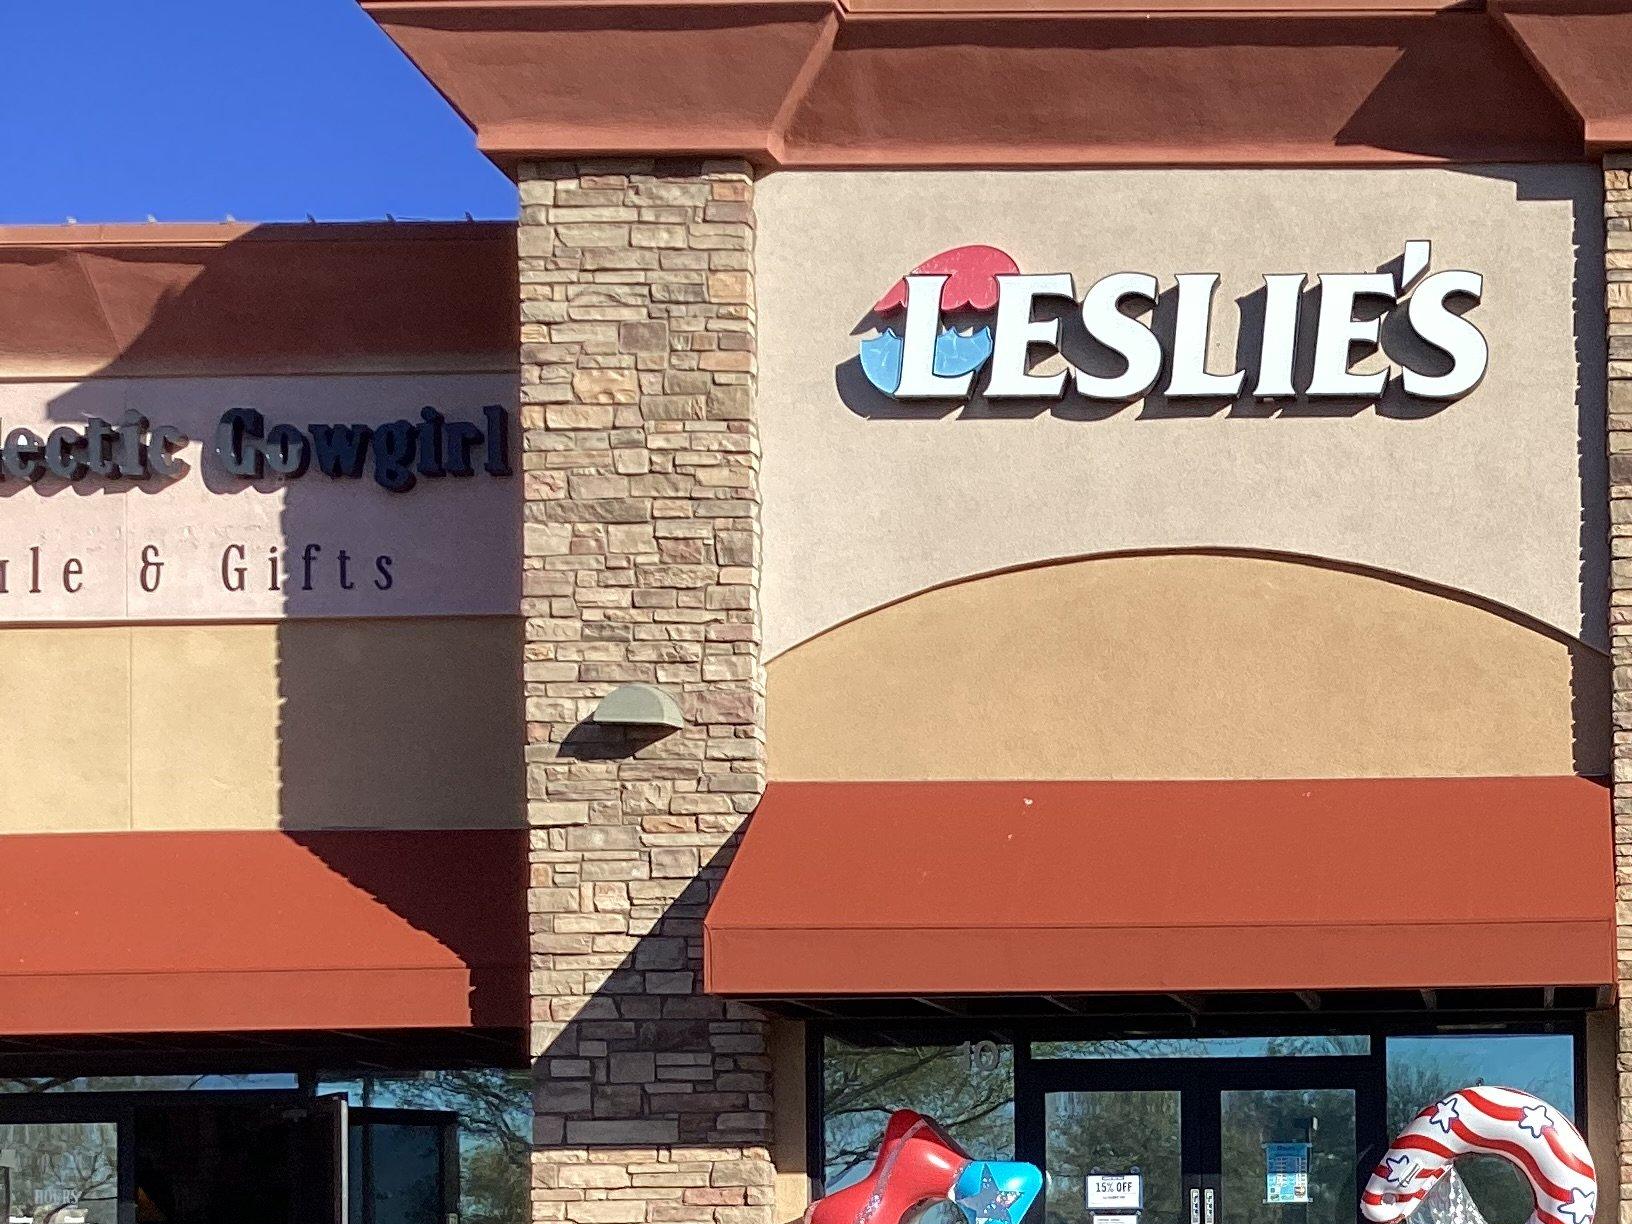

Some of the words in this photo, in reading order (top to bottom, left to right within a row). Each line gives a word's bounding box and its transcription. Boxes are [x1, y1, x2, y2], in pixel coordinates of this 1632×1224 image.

[893, 239, 1489, 399] LESLIE'S
[0, 409, 191, 482] ectic
[216, 403, 512, 493] Cowgirl
[139, 545, 164, 592] &
[221, 544, 394, 593] Gifts
[1095, 1182, 1114, 1192] 15%
[1116, 1182, 1132, 1192] OFF
